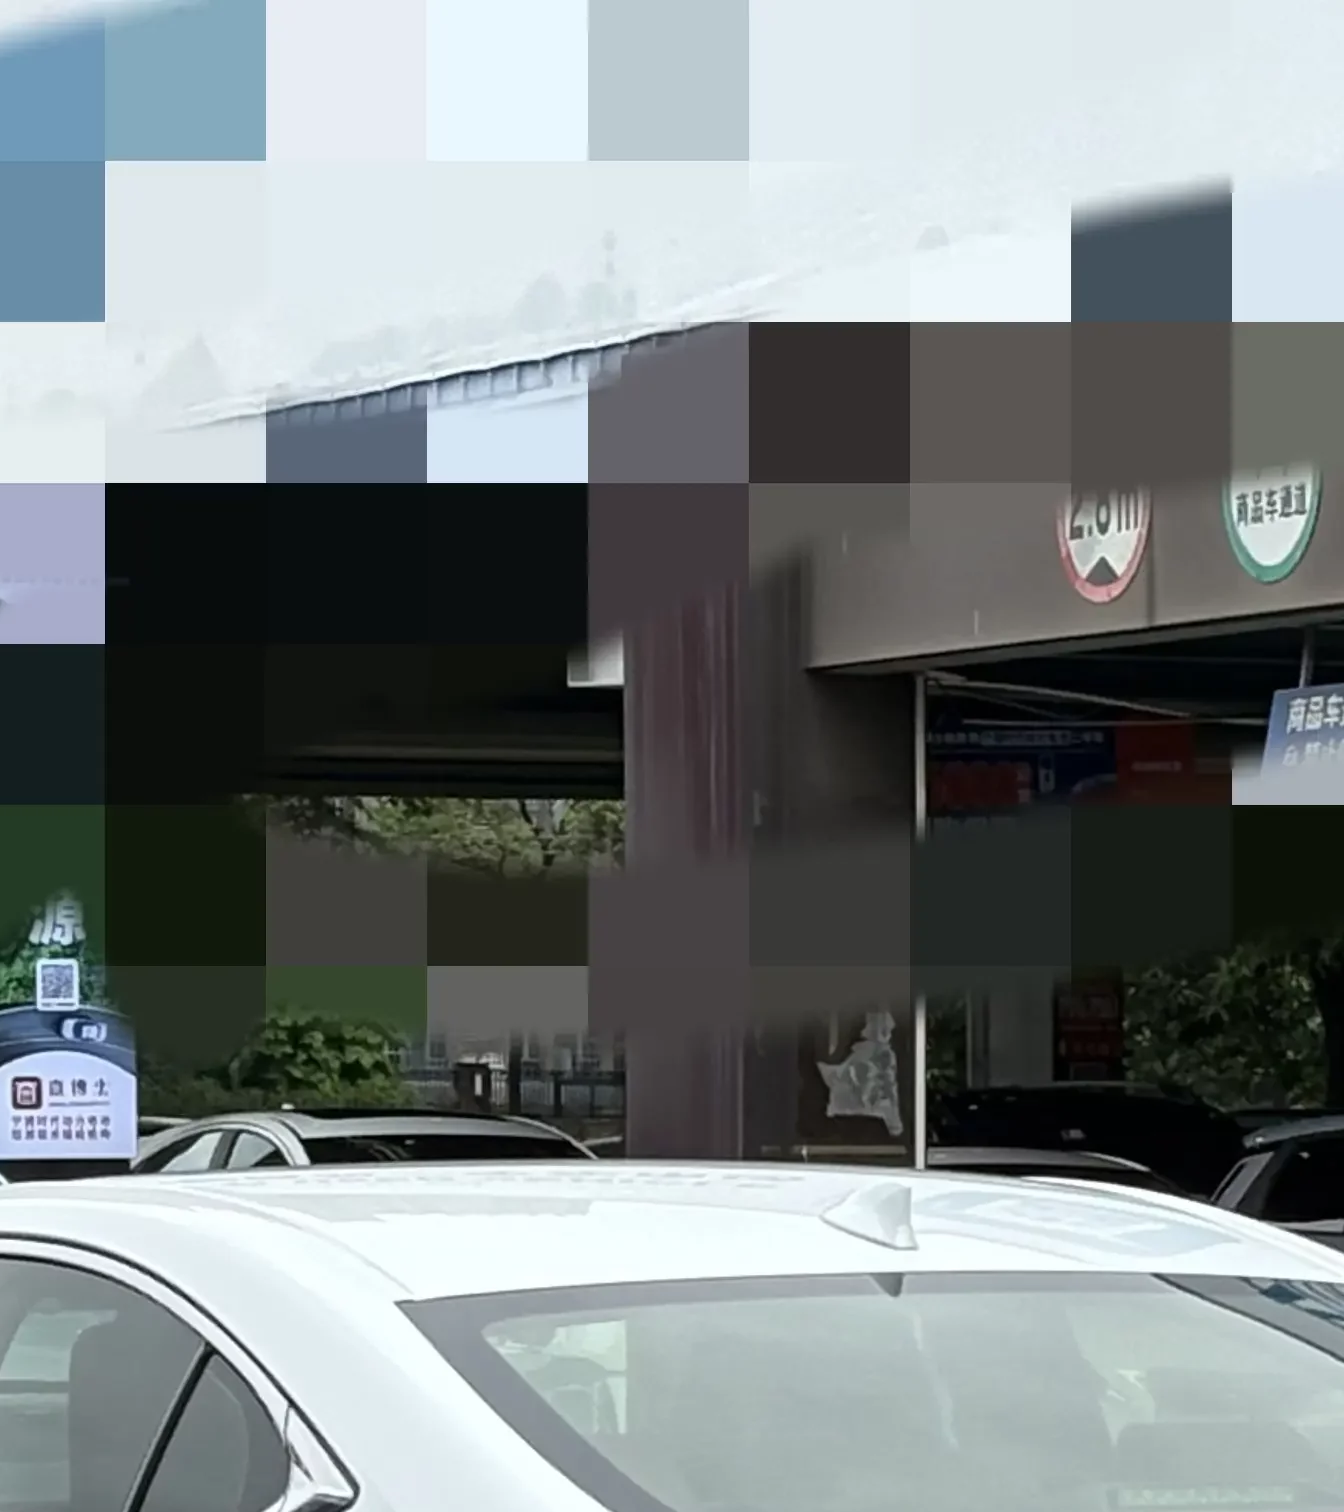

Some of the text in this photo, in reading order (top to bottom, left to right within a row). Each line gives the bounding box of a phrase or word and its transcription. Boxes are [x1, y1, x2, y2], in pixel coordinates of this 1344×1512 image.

[1235, 482, 1308, 526] 商品车通道
